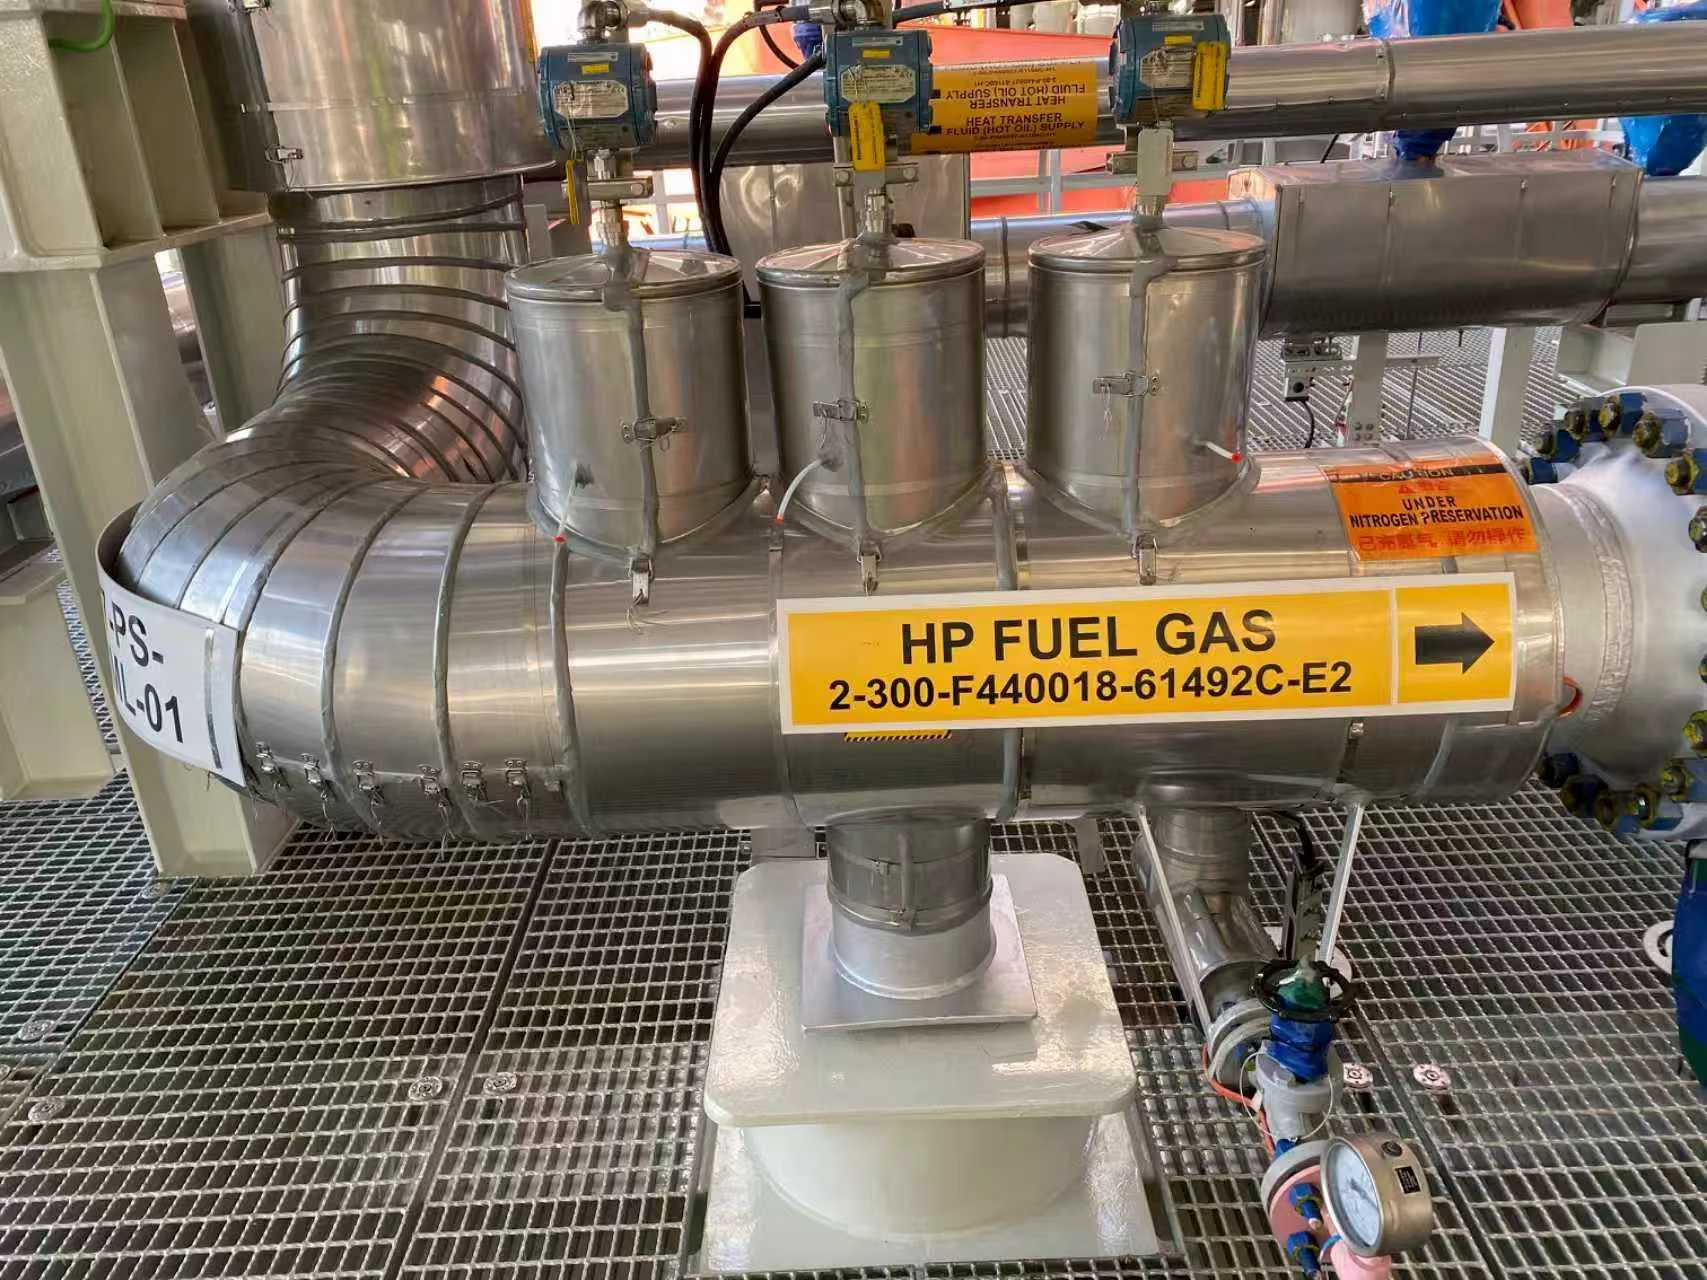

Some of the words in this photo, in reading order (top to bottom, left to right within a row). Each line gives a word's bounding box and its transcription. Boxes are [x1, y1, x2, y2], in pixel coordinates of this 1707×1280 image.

[946, 88, 991, 99] SUPPLY
[1051, 83, 1085, 95] FLUID
[970, 97, 1032, 110] TRANSFER
[1037, 96, 1066, 107] HEAT
[966, 115, 996, 127] HEAT
[1000, 112, 1062, 125] TRANSFER
[946, 126, 980, 136] FLUID
[983, 124, 1011, 136] (HOT
[1015, 123, 1037, 134] OIL)
[1040, 120, 1085, 132] SUPPLY
[1379, 468, 1454, 482] CAUTION
[1401, 495, 1457, 512] UNDER
[1350, 511, 1418, 529] NITROGEN
[1421, 504, 1524, 526] PRESERVATION
[901, 621, 974, 665] HP
[994, 615, 1138, 662] FUEL
[1156, 609, 1277, 655] GAS
[828, 660, 1353, 711] 2-300-F440018-61492C-E2
